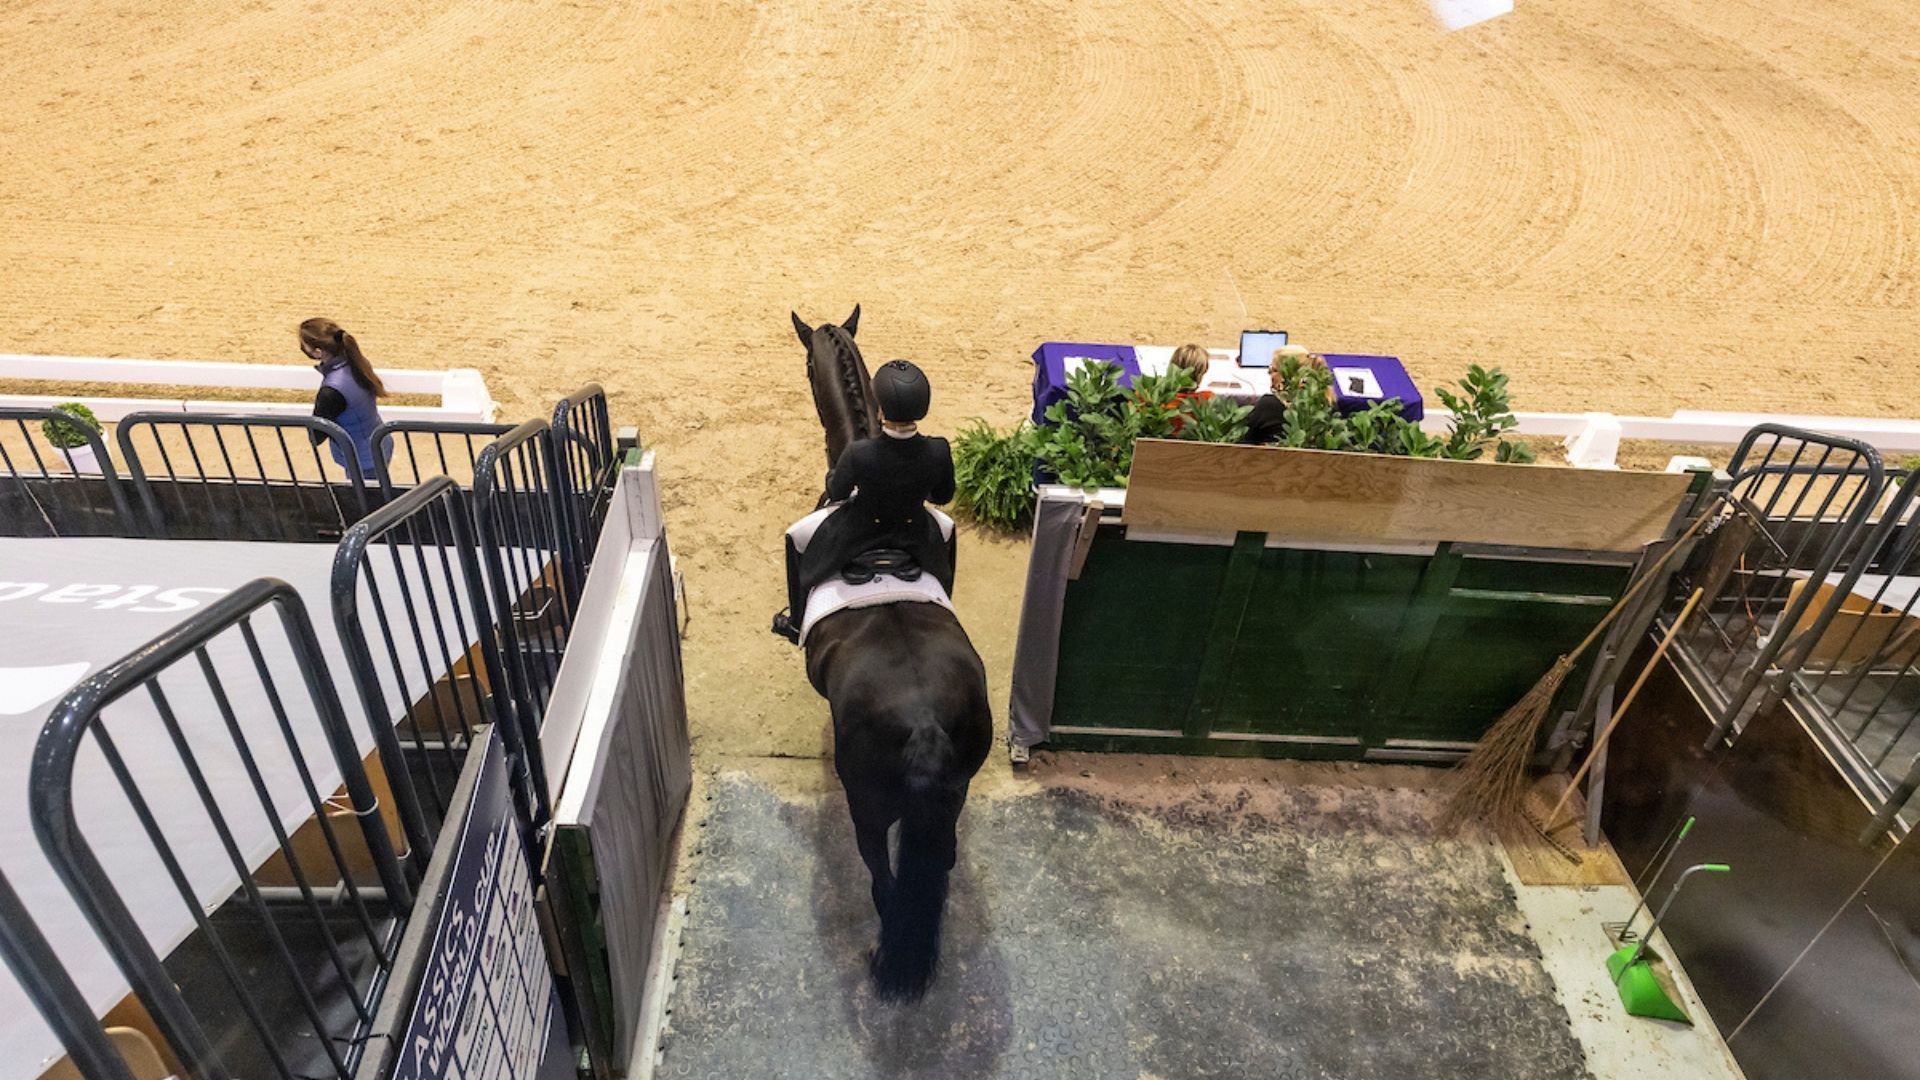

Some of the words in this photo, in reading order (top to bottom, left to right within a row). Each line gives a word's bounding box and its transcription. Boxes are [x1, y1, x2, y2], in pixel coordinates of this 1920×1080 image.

[405, 900, 463, 1080] ASSICS
[429, 915, 476, 1075] WORLD
[475, 831, 495, 913] CUP
